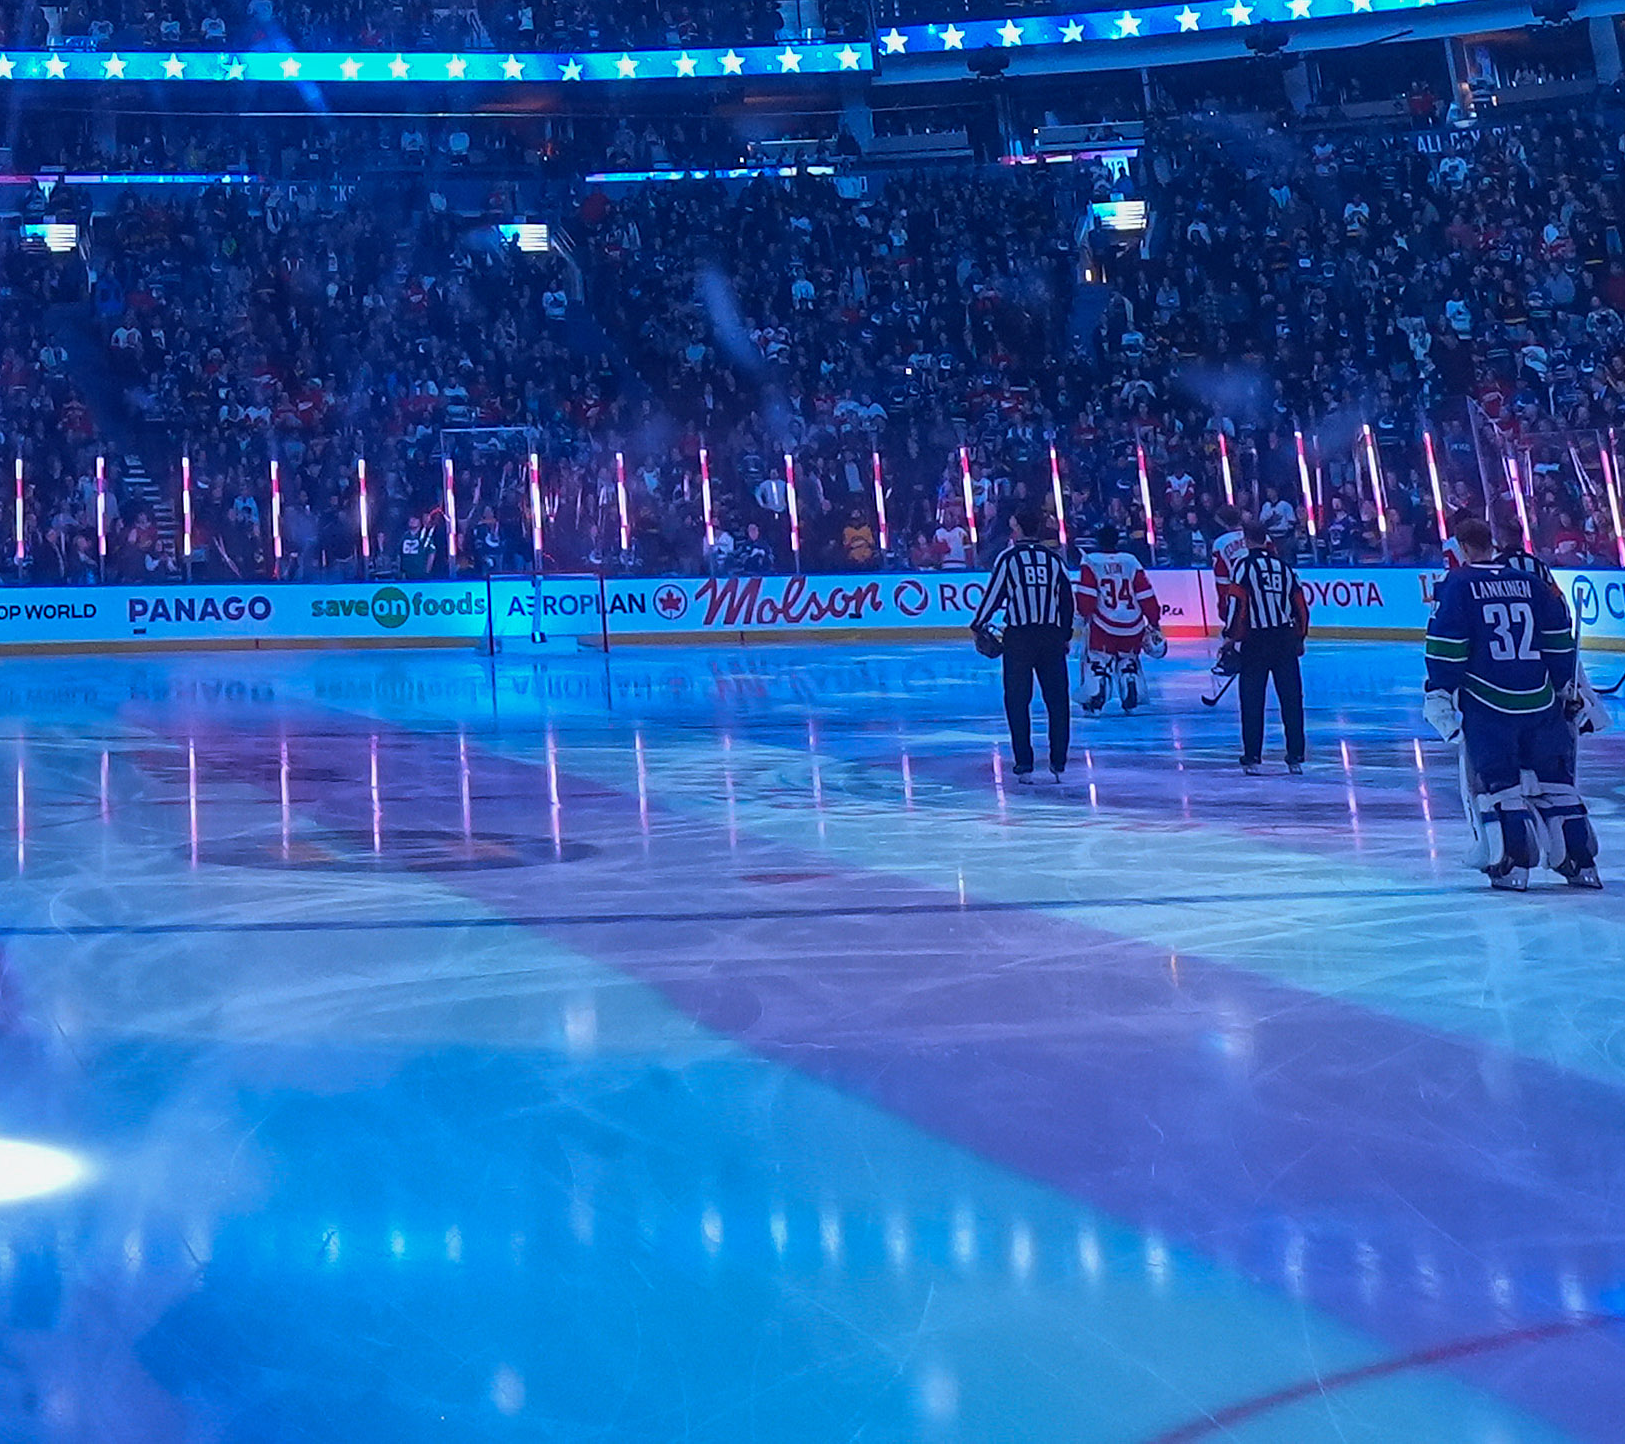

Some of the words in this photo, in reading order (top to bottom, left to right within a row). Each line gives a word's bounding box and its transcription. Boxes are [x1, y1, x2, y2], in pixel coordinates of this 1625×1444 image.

[1025, 566, 1049, 585] 89
[1261, 572, 1283, 592] 38
[695, 574, 884, 626] Molson
[1100, 578, 1136, 610] 34
[1301, 581, 1384, 608] OYOTA
[1469, 580, 1532, 600] LANKINEN
[25, 603, 97, 619] WORLD
[129, 595, 272, 623] PANAGO
[1482, 602, 1542, 661] 32
